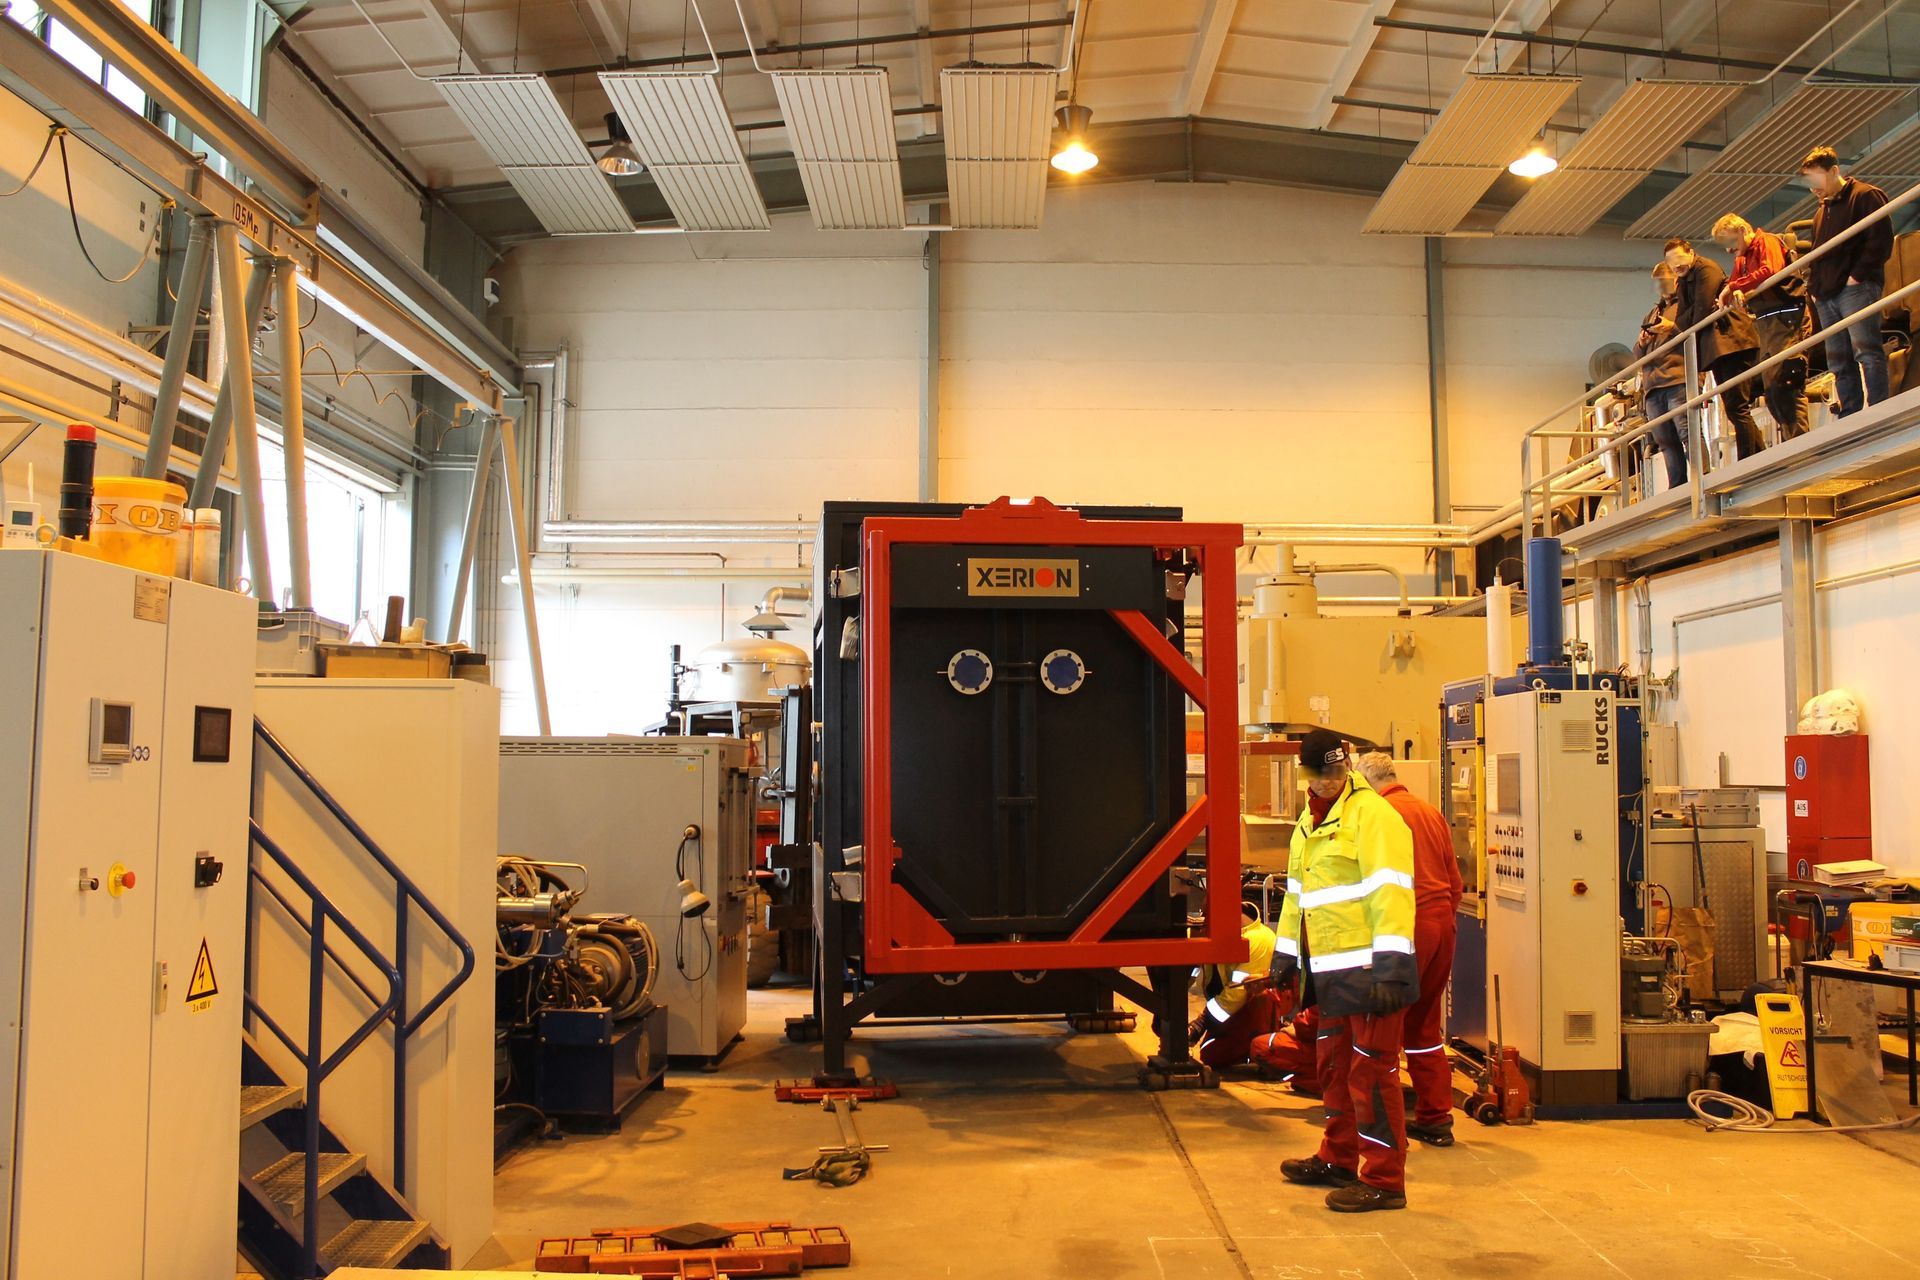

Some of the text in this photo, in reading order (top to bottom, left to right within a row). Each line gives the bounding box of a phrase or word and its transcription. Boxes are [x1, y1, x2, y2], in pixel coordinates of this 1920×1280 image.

[976, 567, 1072, 588] XERION
[1595, 697, 1609, 765] RUCKS
[1769, 1026, 1803, 1036] VORSICHT
[1777, 1073, 1807, 1082] RUTSCHGE
